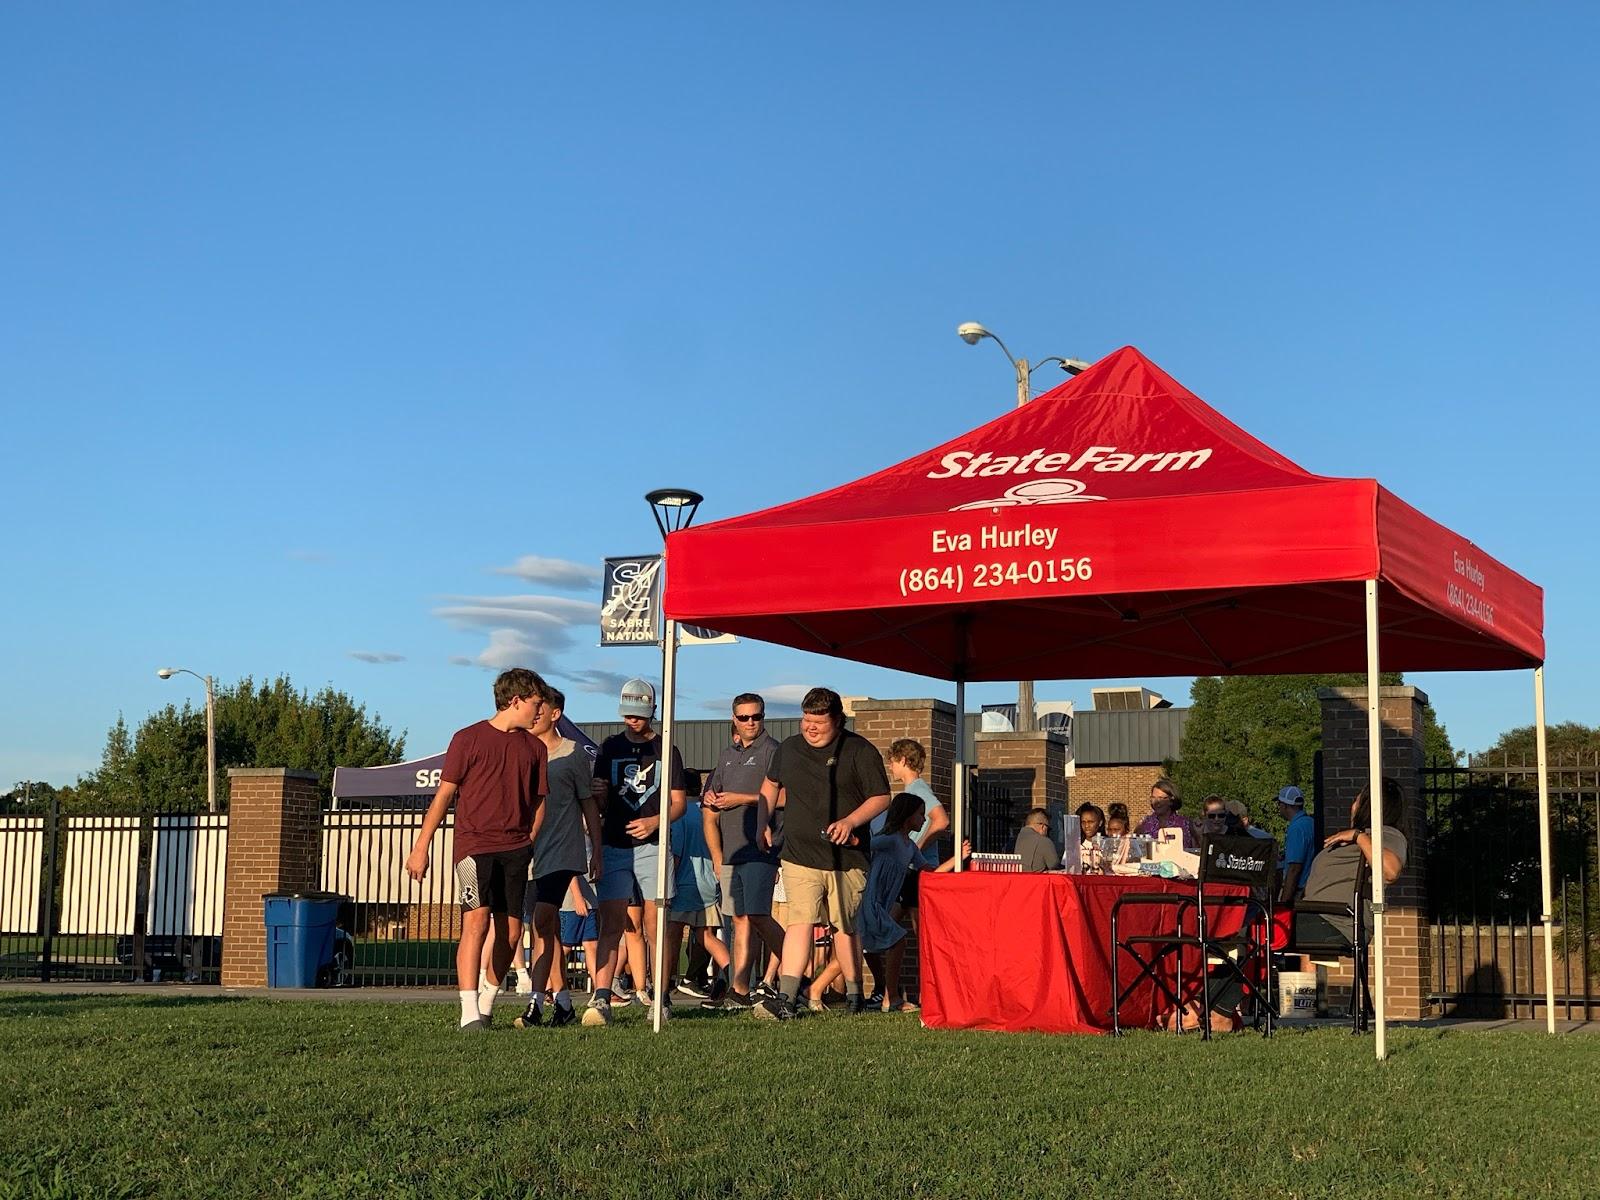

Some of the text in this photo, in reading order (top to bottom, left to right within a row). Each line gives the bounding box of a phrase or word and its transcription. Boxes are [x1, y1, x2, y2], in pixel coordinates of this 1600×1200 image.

[932, 523, 1059, 552] Eva Hurley
[1453, 550, 1465, 576] Eva
[899, 557, 1093, 597] (864) 234-0156
[606, 631, 654, 641] NATION
[609, 618, 651, 628] SABRE
